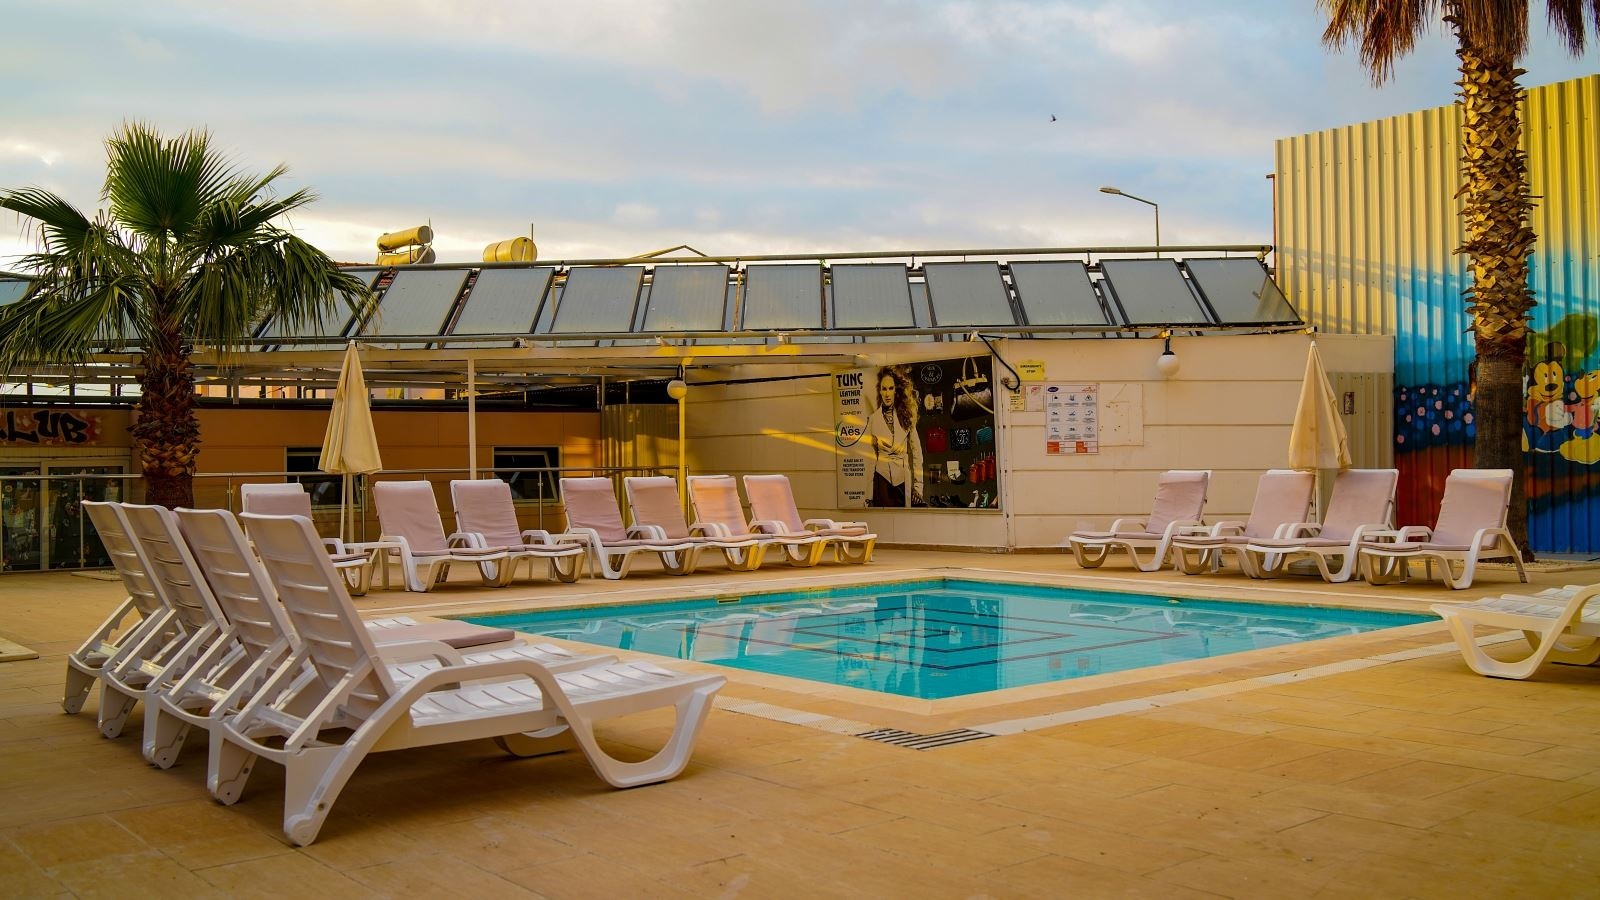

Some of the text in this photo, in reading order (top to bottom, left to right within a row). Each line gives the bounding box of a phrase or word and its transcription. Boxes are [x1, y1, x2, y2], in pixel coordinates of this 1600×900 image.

[836, 373, 863, 389] TUNÇ
[0, 410, 89, 444] LUB
[840, 426, 861, 436] Aes
